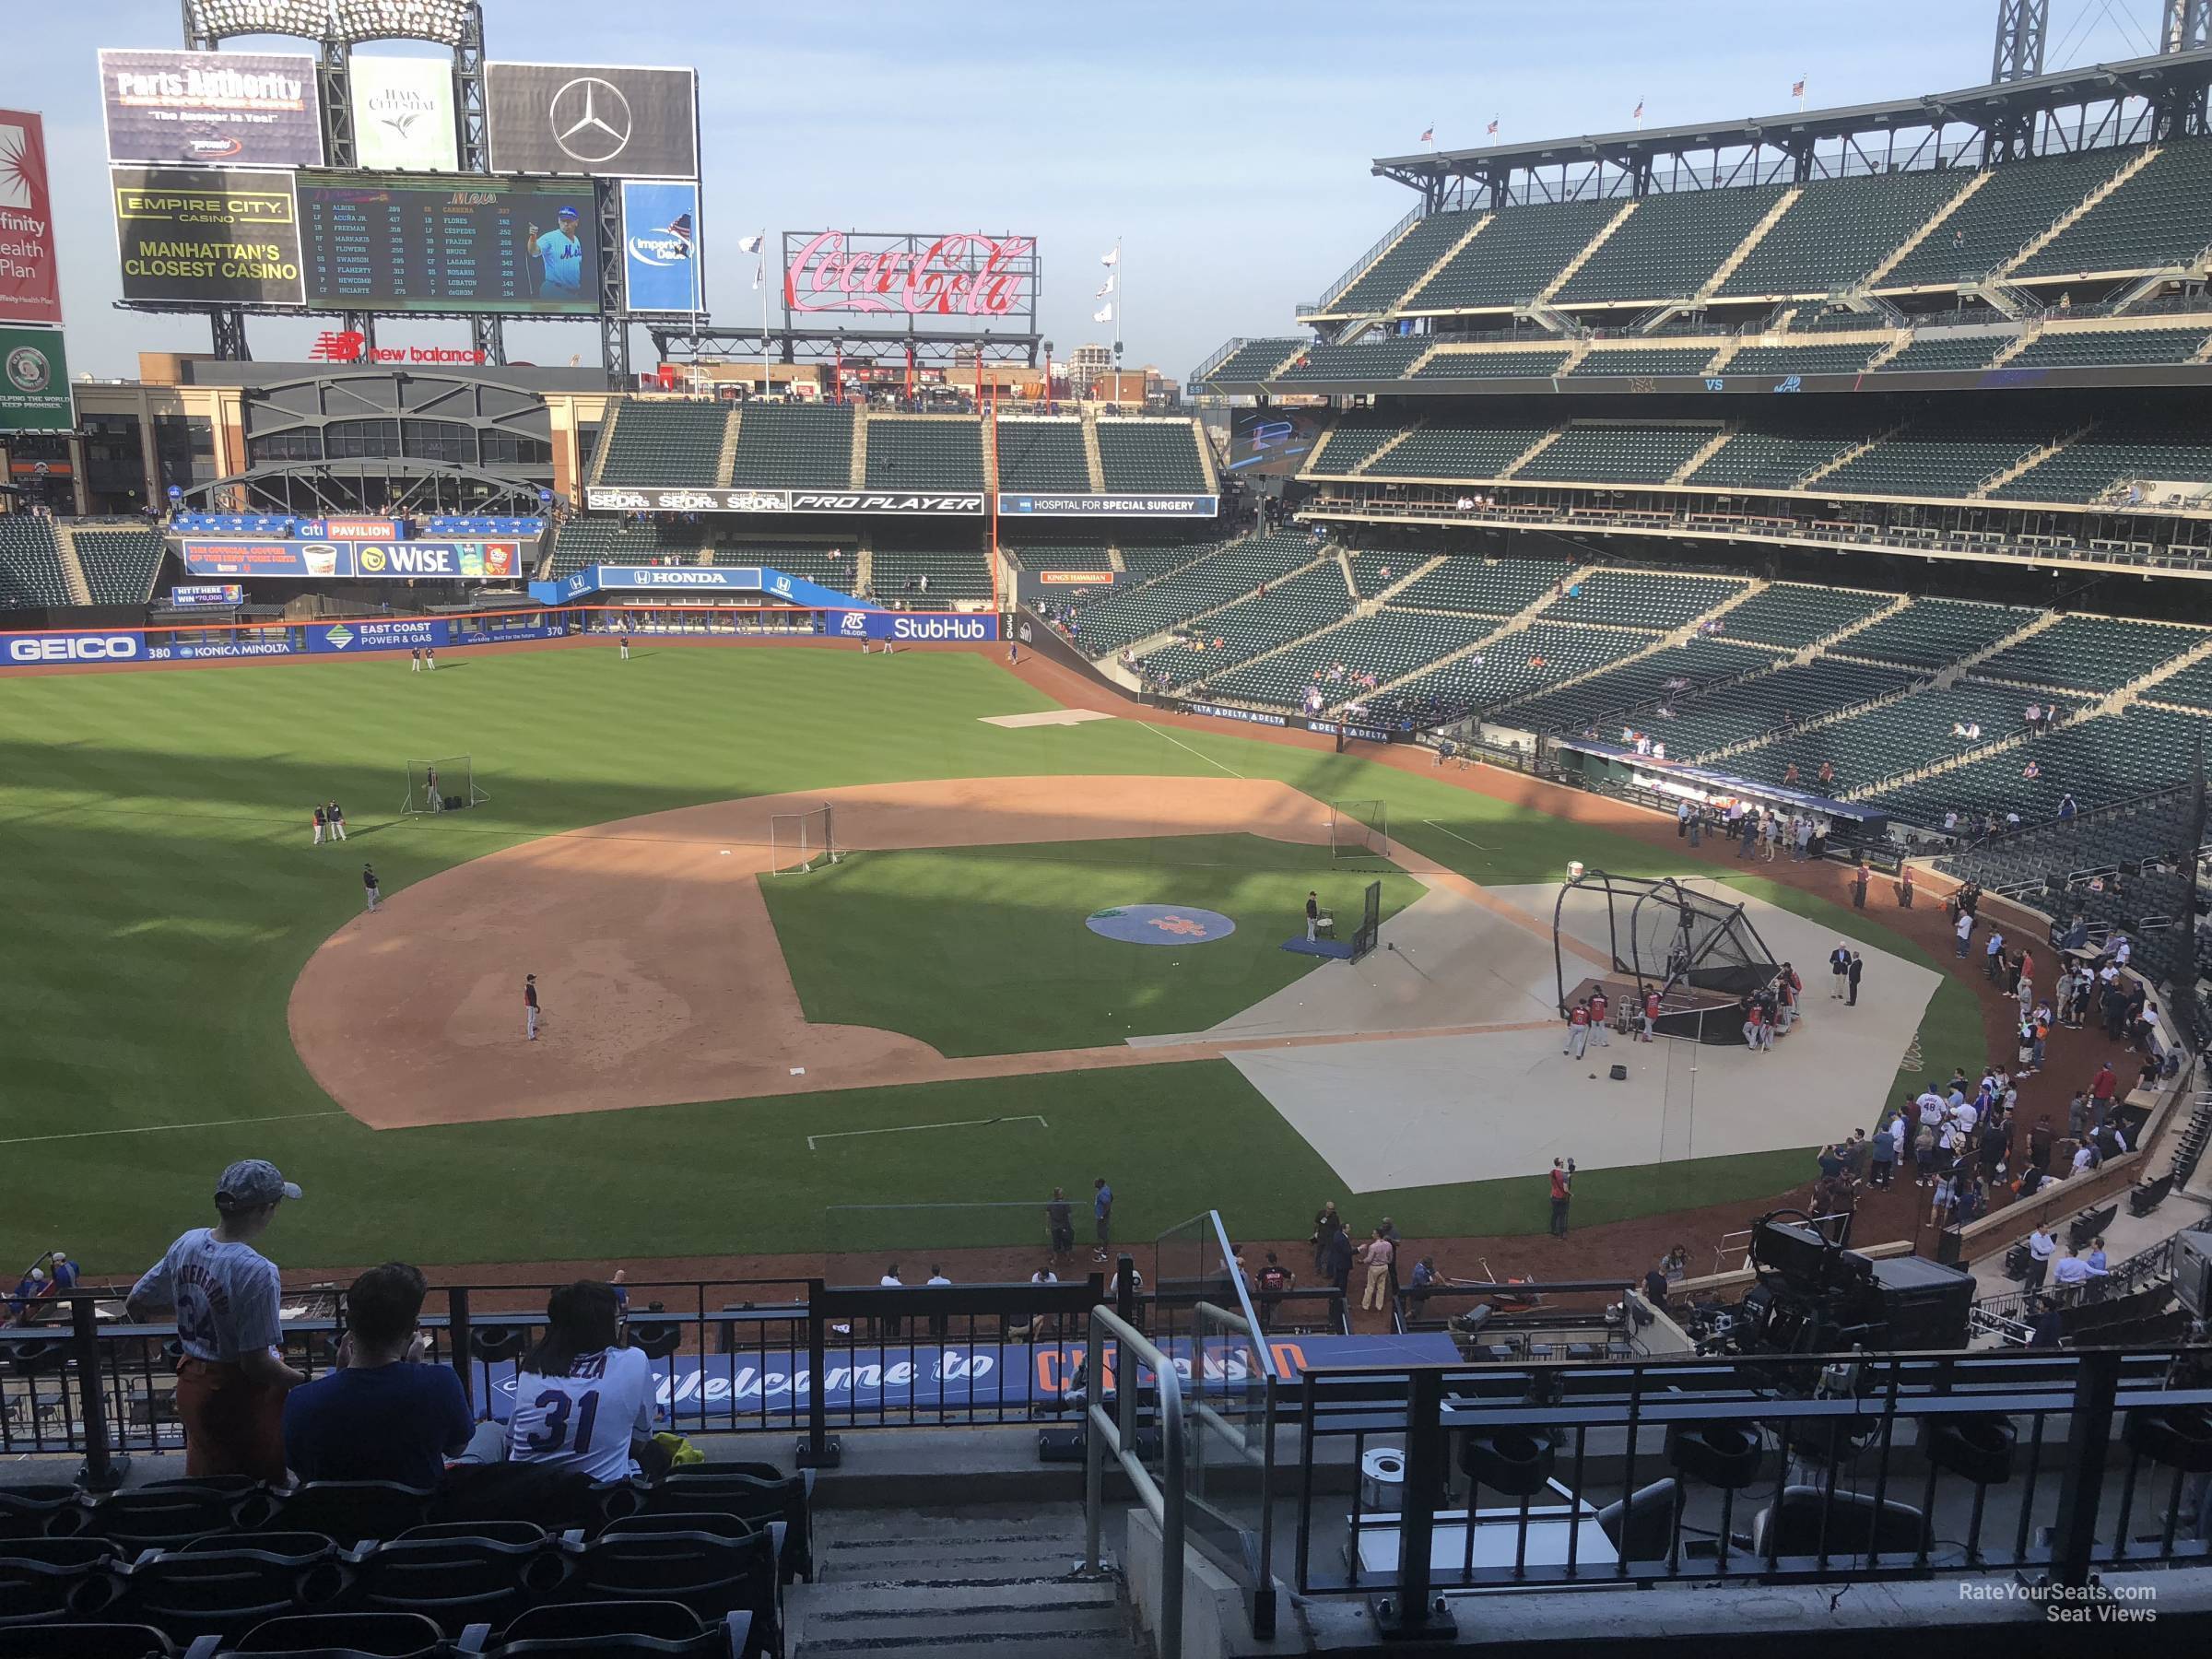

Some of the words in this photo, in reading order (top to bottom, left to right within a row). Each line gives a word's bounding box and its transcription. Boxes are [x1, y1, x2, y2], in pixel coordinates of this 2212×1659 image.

[118, 71, 183, 97] Parts
[187, 68, 302, 100] Authority
[127, 197, 221, 212] EMPIRE
[179, 214, 235, 223] CASINO
[139, 241, 280, 261] MANHATTAN'S
[0, 258, 36, 278] Plan
[124, 259, 217, 277] CLOSEST
[221, 263, 298, 280] CASINO
[784, 230, 1038, 314] Coca-Cola
[369, 347, 406, 361] new
[410, 347, 486, 363] balance
[1704, 379, 1724, 391] VS
[793, 496, 861, 509] PRO
[861, 498, 981, 510] PLAYER
[1034, 500, 1080, 510] HOSPITAL
[1082, 500, 1100, 510] FOR
[1102, 500, 1146, 510] SPECIAL
[1147, 501, 1194, 511] SURGERY
[332, 526, 391, 536] PAVILION
[653, 572, 727, 583] HONDA
[568, 585, 592, 597] HONDA
[770, 586, 794, 598] HONDA
[841, 612, 866, 629] RTS
[360, 624, 392, 634] EAST
[393, 622, 431, 633] COAST
[547, 627, 563, 636] 370
[841, 629, 866, 637] rts.com
[894, 618, 985, 639] StubHub
[361, 634, 401, 645] POWER
[402, 634, 409, 643] &
[410, 633, 432, 643] GAS
[10, 636, 136, 661] GEICO
[148, 648, 171, 659] 380
[194, 645, 239, 657] KONICA
[241, 643, 290, 654] MINOLTA
[1193, 704, 1211, 713] ELTA
[1222, 709, 1248, 719] DELTA
[1259, 713, 1285, 724] DELTA
[1359, 729, 1387, 740] DELTA
[1924, 1101, 1936, 1112] 48
[652, 1360, 919, 1405] Welcome
[933, 1349, 994, 1382] to
[527, 1389, 599, 1454] 31
